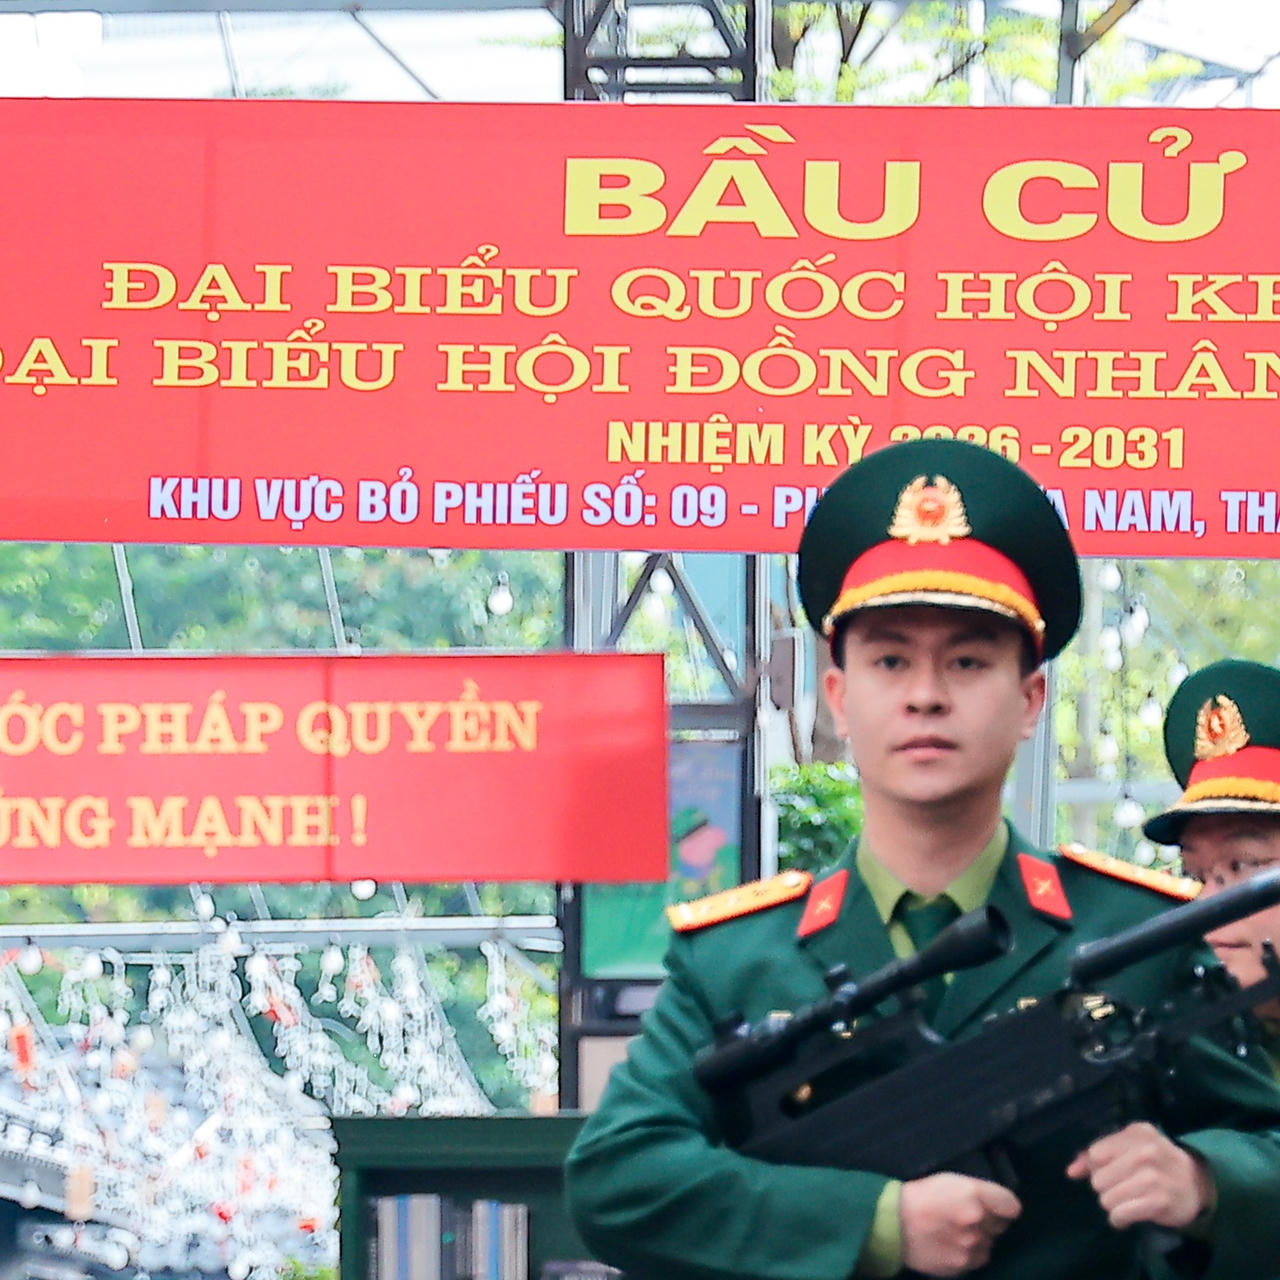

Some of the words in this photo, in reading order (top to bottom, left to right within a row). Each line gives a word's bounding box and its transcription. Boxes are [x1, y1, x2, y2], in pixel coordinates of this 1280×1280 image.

[563, 123, 922, 241] BẦU
[982, 125, 1248, 243] CỬ
[100, 261, 293, 323] ĐẠI
[325, 243, 579, 317] BIỂU
[610, 252, 906, 322] QUỐC
[935, 259, 1133, 333] HỘI
[151, 317, 405, 392] BIỂU
[435, 332, 632, 404] HỘI
[664, 324, 976, 398] ĐỒNG
[606, 412, 786, 475] NHIỆM
[802, 414, 874, 467] KỲ
[1058, 425, 1185, 470] 2031
[148, 476, 241, 521] KHU
[254, 474, 344, 531] VỰC
[357, 466, 419, 524] BỎ
[436, 469, 569, 526] PHIẾU
[581, 474, 657, 527] SỐ:
[670, 484, 727, 528] 09
[1083, 488, 1206, 539] NAM,
[97, 690, 281, 755] PHÁP
[297, 680, 540, 759] QUYỀN
[127, 794, 341, 858] MẠNH
